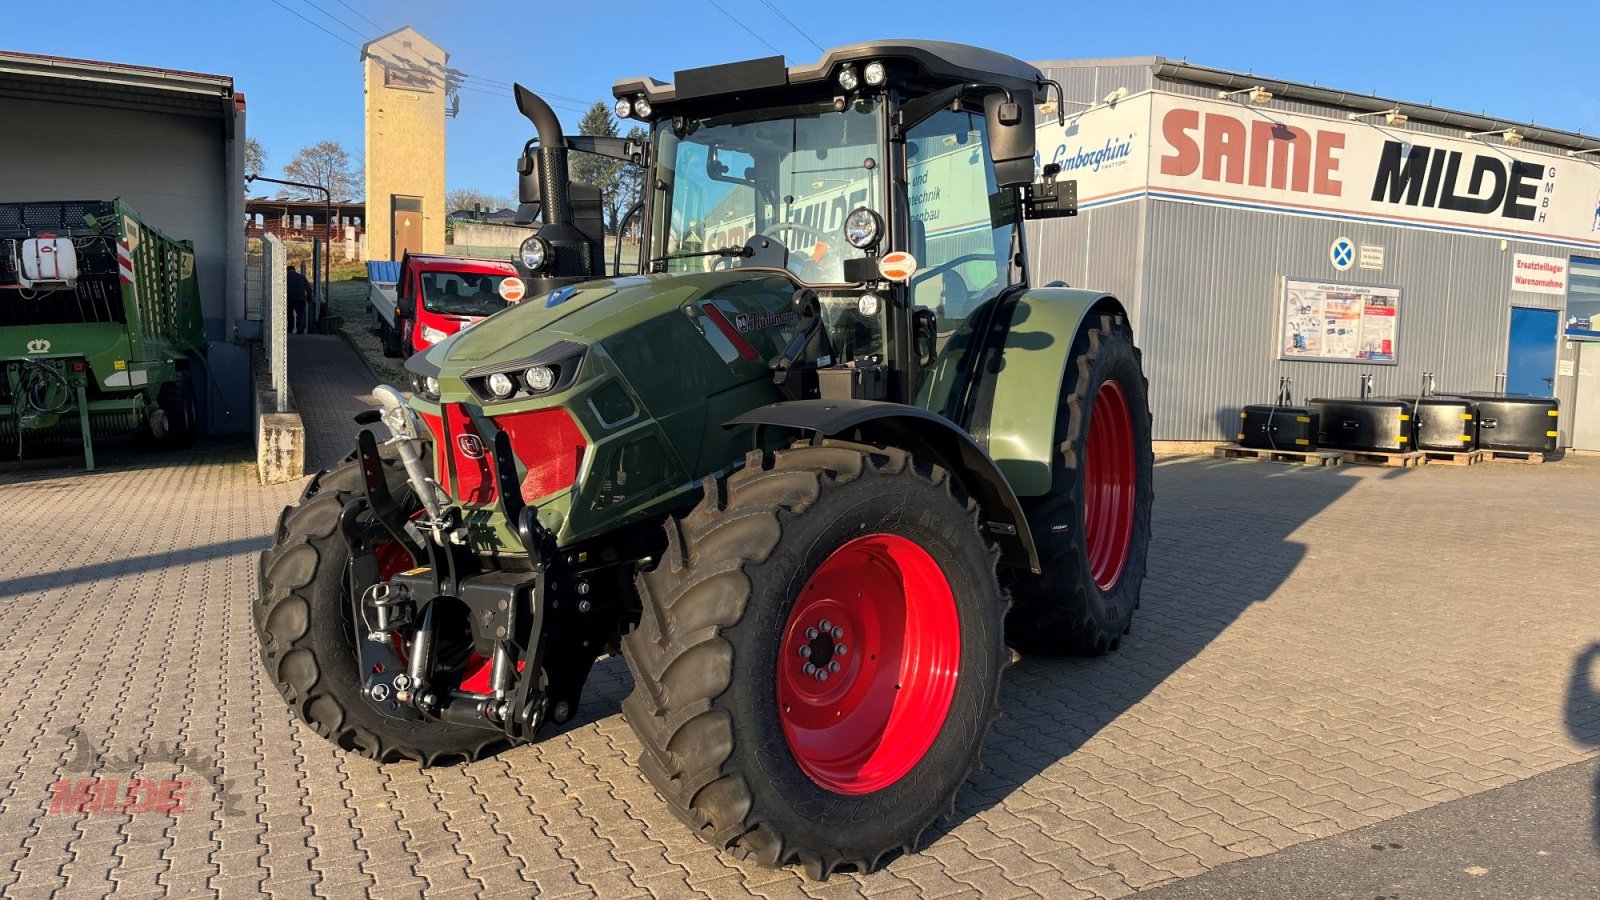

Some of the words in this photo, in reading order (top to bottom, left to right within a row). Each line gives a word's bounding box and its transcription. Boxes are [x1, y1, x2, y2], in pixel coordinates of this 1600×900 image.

[1051, 133, 1133, 173] Lamborghini
[1160, 108, 1346, 197] SAME
[1371, 140, 1546, 221] MILDE
[912, 170, 929, 187] und
[1516, 259, 1563, 274] Ersatzteillager
[1514, 275, 1563, 288] Warenannahme
